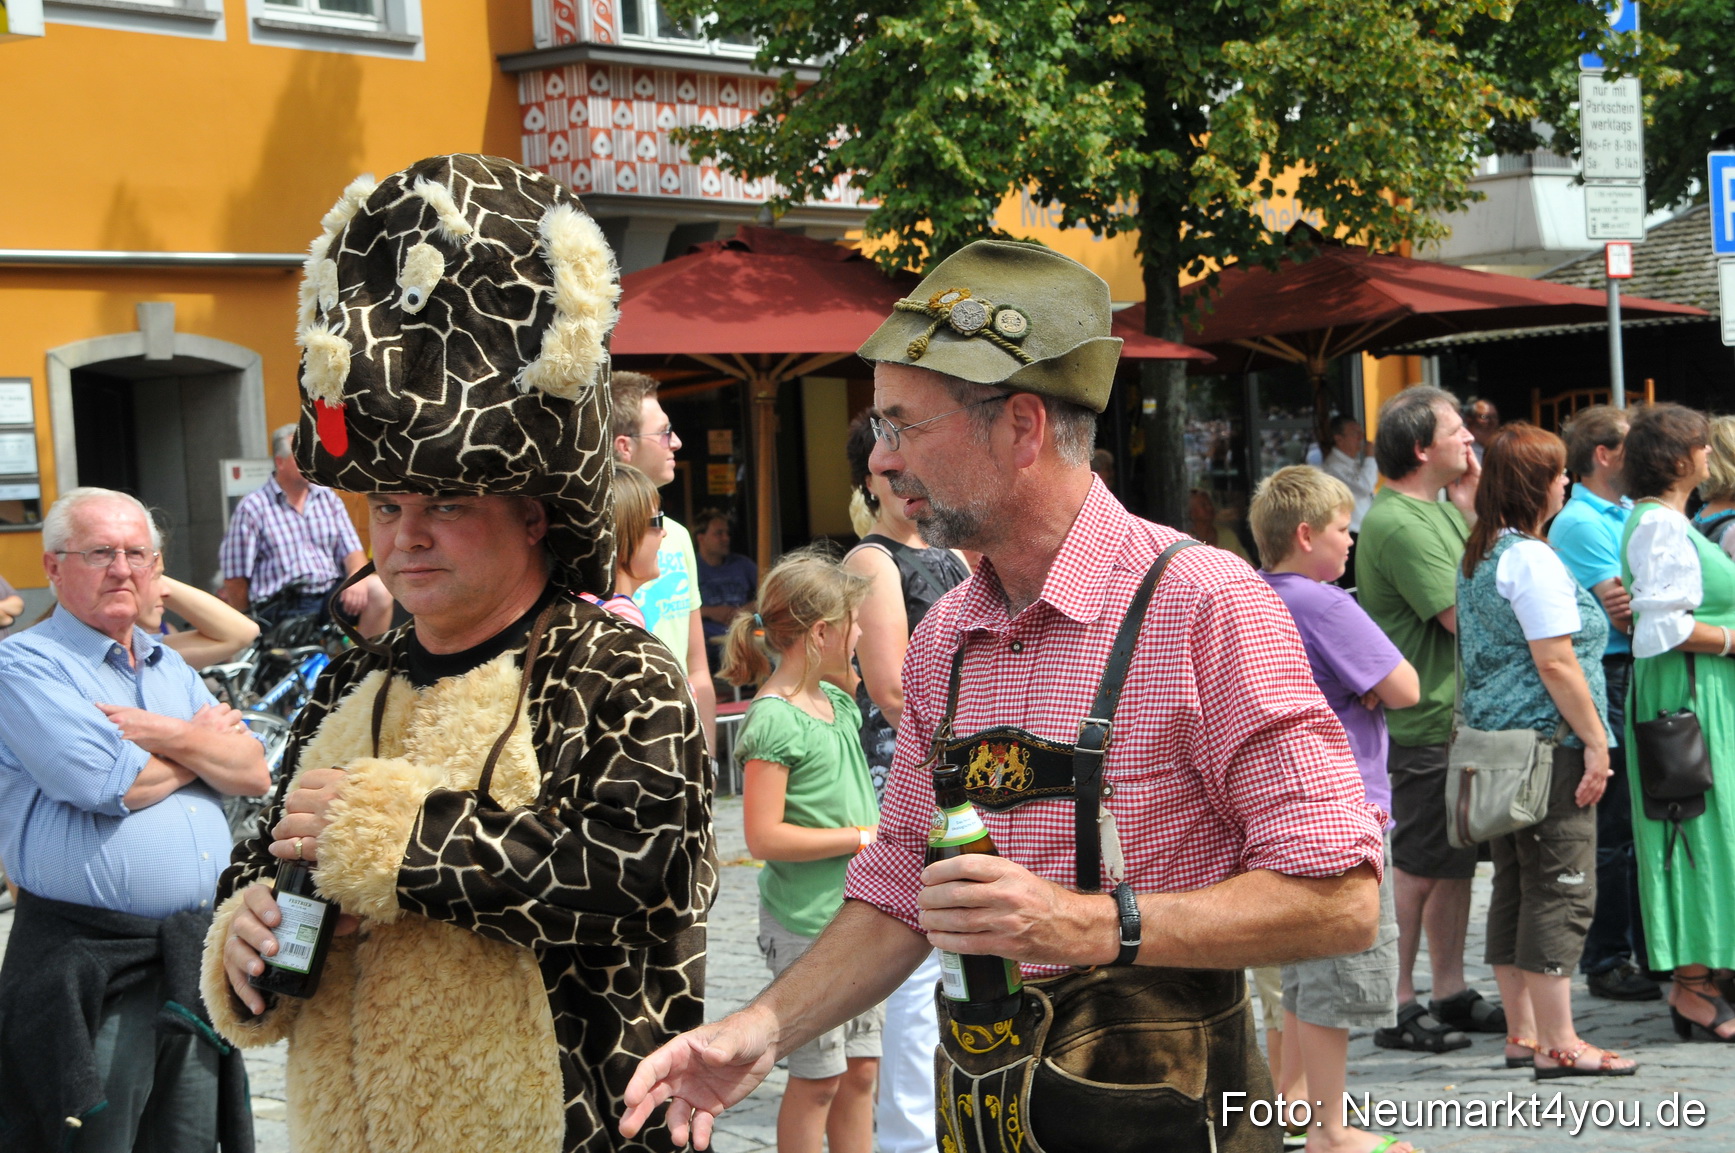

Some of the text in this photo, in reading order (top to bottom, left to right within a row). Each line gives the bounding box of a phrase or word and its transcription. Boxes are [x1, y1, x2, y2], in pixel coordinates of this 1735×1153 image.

[1593, 85, 1627, 97] nur mit
[1586, 100, 1635, 114] Parkschein
[1590, 119, 1632, 134] werktags
